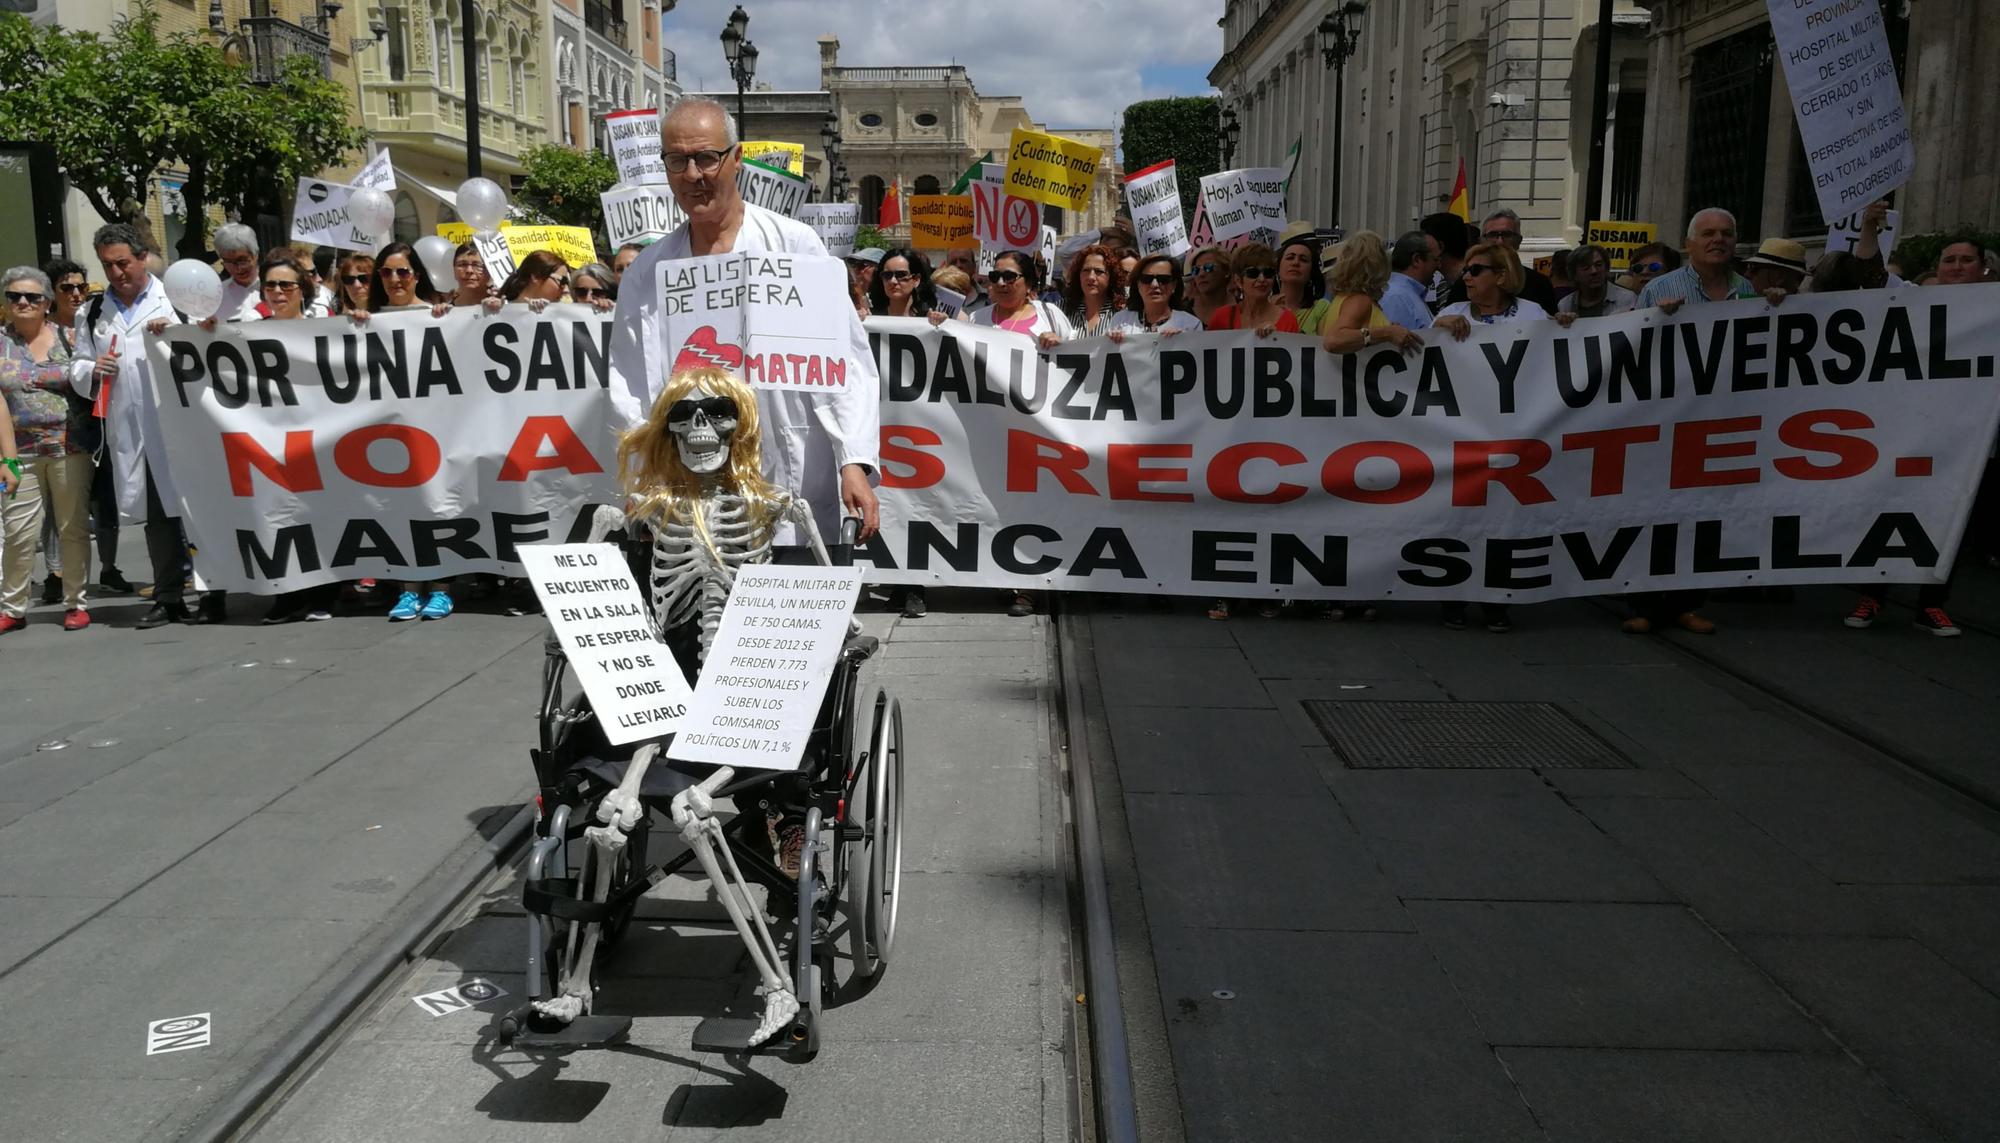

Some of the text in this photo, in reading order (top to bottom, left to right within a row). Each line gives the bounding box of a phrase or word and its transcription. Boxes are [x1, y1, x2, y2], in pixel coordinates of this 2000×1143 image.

[1790, 32, 1850, 66] HOSPITAL
[1819, 42, 1876, 80] DE SEVILLA
[1800, 79, 1858, 116] CERRADO
[1861, 73, 1871, 88] 13
[1847, 97, 1874, 120] Y SIN
[613, 121, 635, 141] SUSANA
[1810, 123, 1876, 164] PERSPECTIVA
[1878, 114, 1890, 130] DE
[1012, 139, 1096, 175] ¿Cuántos más
[1816, 172, 1834, 188] EN
[1836, 158, 1868, 179] TOTAL
[1840, 159, 1906, 204] PROGRESIVO.
[1011, 168, 1047, 190] deben
[1048, 182, 1087, 201] morir?
[1206, 177, 1283, 203] Hoy, al saquear
[296, 205, 350, 236] SANIDAD-N
[817, 212, 825, 225] lo
[973, 184, 1039, 248] NO
[1212, 207, 1245, 228] llaman
[509, 230, 554, 246] sanidad:
[665, 256, 792, 288] LAS LISTAS
[665, 283, 803, 316] DE ESPERA
[170, 339, 298, 408] POR
[314, 327, 463, 404] UNA
[1160, 345, 1461, 420] PUBLICA
[1479, 339, 1530, 414] Y
[1553, 304, 1994, 409] UNIVERSAL.
[744, 353, 846, 387] MATAN
[221, 423, 441, 497] NO
[497, 415, 604, 482] A
[1006, 409, 1933, 507] RECORTES.
[554, 553, 598, 568] ME LO
[1191, 530, 1348, 587] EN
[1397, 512, 1940, 589] SEVILLA
[544, 578, 630, 595] ENCUENTRO
[740, 577, 853, 591] HOSPITAL MILITAR DE
[560, 603, 641, 622] EN LA SALA
[734, 597, 846, 610] SEVILLA, UN MUERTO
[743, 616, 822, 630] DE 750 CAMAS.
[575, 628, 652, 648] DE ESPERA
[737, 637, 815, 651] DESDE 2012 SE
[597, 654, 655, 673] Y NO SE
[729, 656, 808, 671] PIERDEN 7.773
[616, 680, 665, 699] DONDE
[714, 675, 810, 691] PROFESIONALES Y
[723, 696, 784, 710] SUBEN LOS
[617, 703, 687, 728] LLEVARLO
[712, 715, 780, 731] COMISARIOS
[685, 733, 791, 752] POLÍTICOS UN 7,1 %
